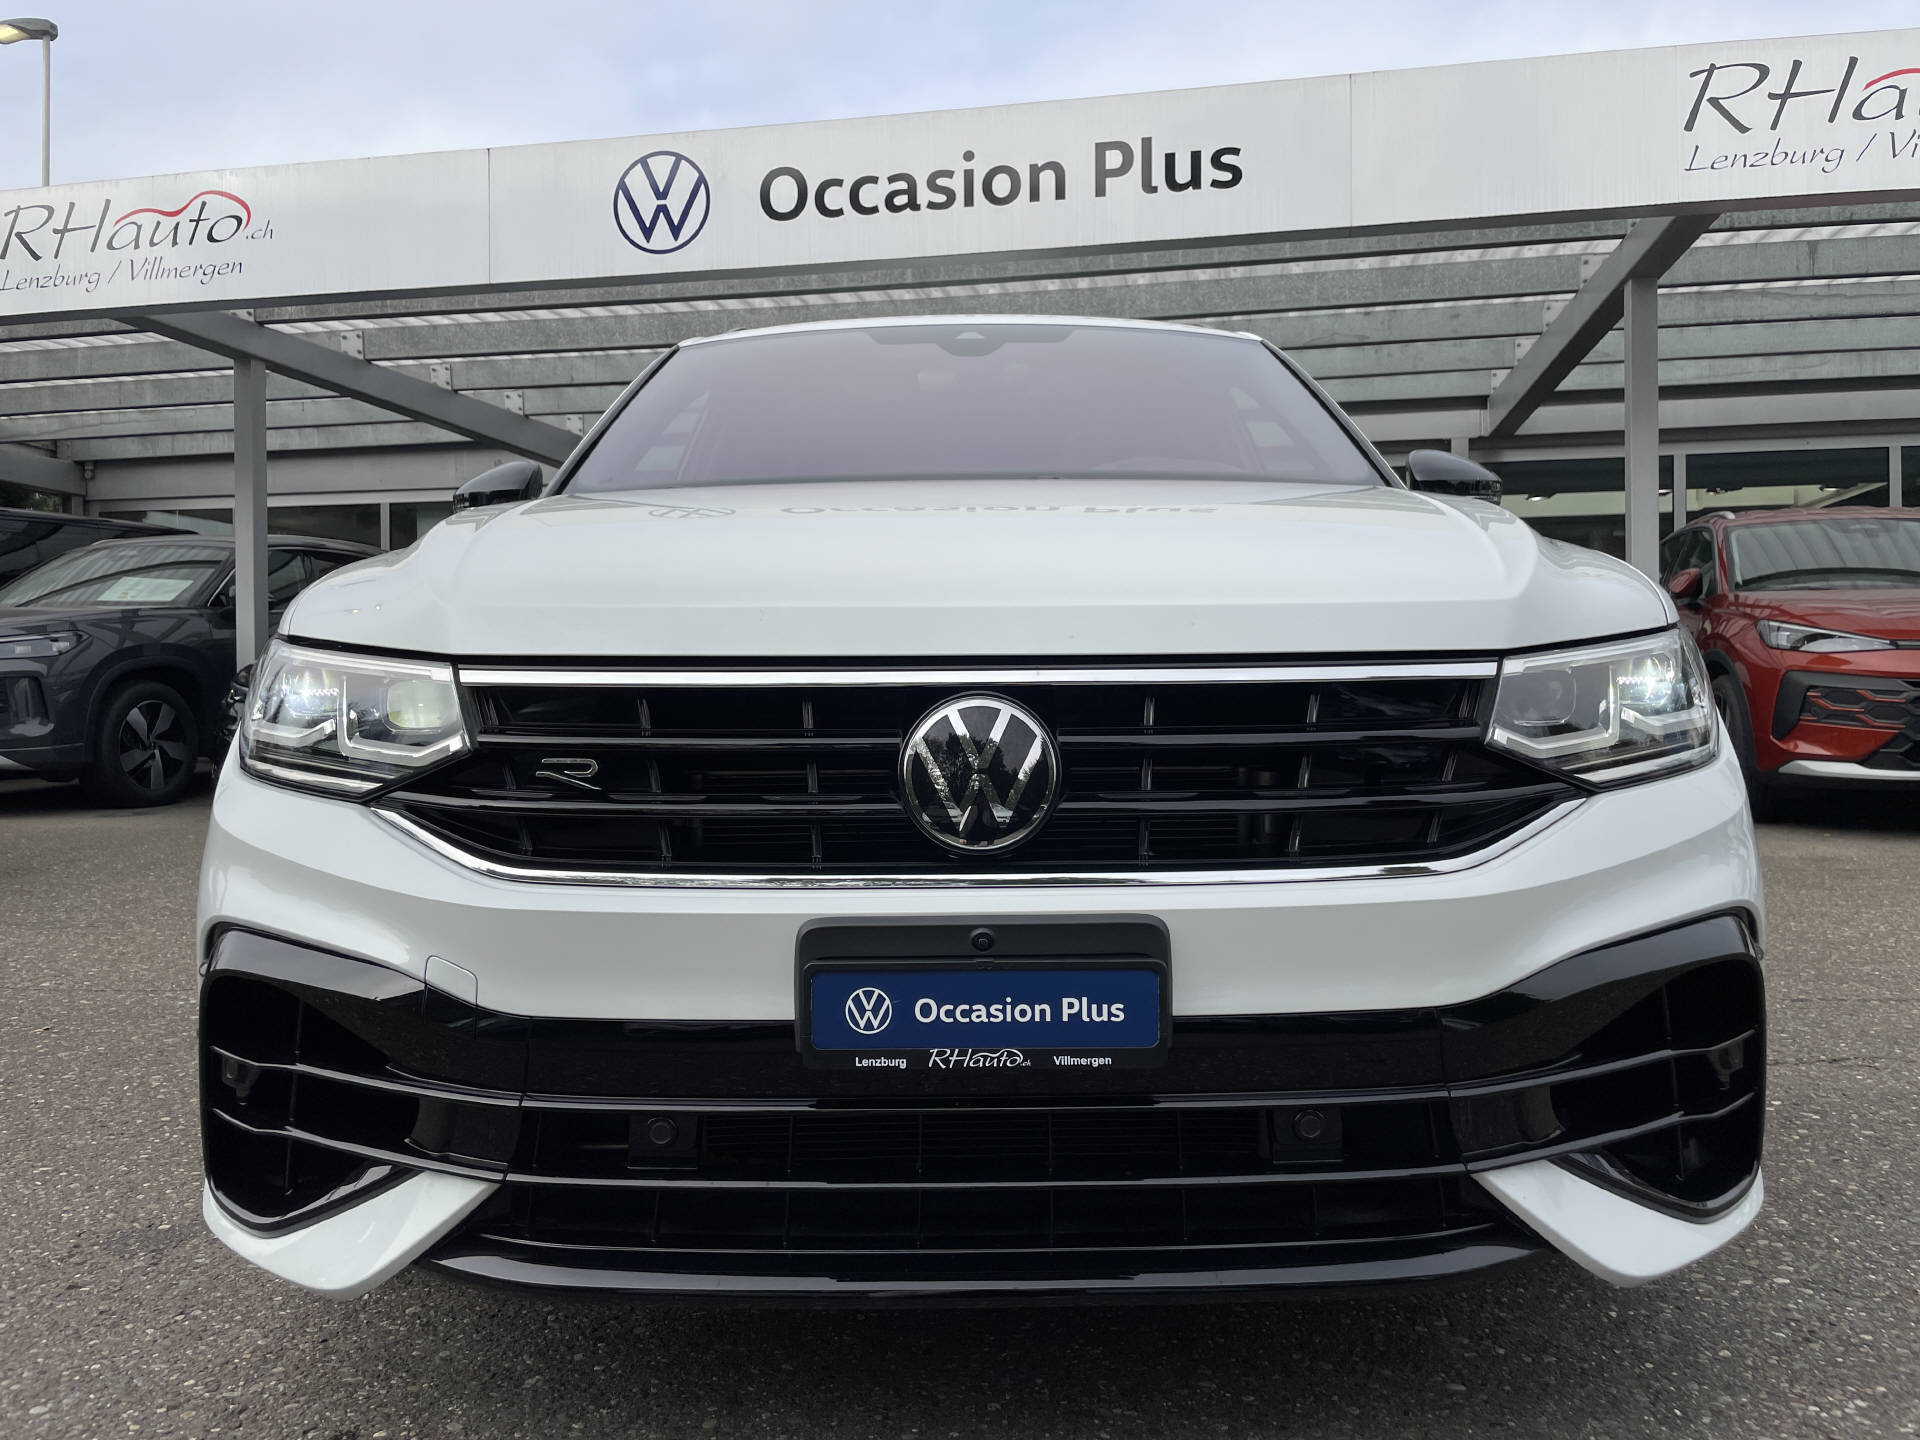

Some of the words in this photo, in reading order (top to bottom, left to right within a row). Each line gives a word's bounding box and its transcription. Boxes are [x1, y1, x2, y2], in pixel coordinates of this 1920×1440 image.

[1683, 55, 1920, 134] RHa
[1684, 137, 1845, 174] Lenzburg
[614, 150, 711, 254] VW
[758, 149, 1067, 222] Occasion
[1093, 135, 1244, 199] Plus
[0, 263, 101, 293] Lenzburg
[129, 256, 244, 286] Villmergen
[535, 757, 602, 790] R
[903, 693, 1058, 853] VW
[845, 987, 893, 1035] VW
[914, 996, 1052, 1024] Occasion
[1061, 997, 1125, 1023] Plus
[855, 1056, 907, 1069] Lenzburg
[1053, 1055, 1112, 1067] Villmergen
